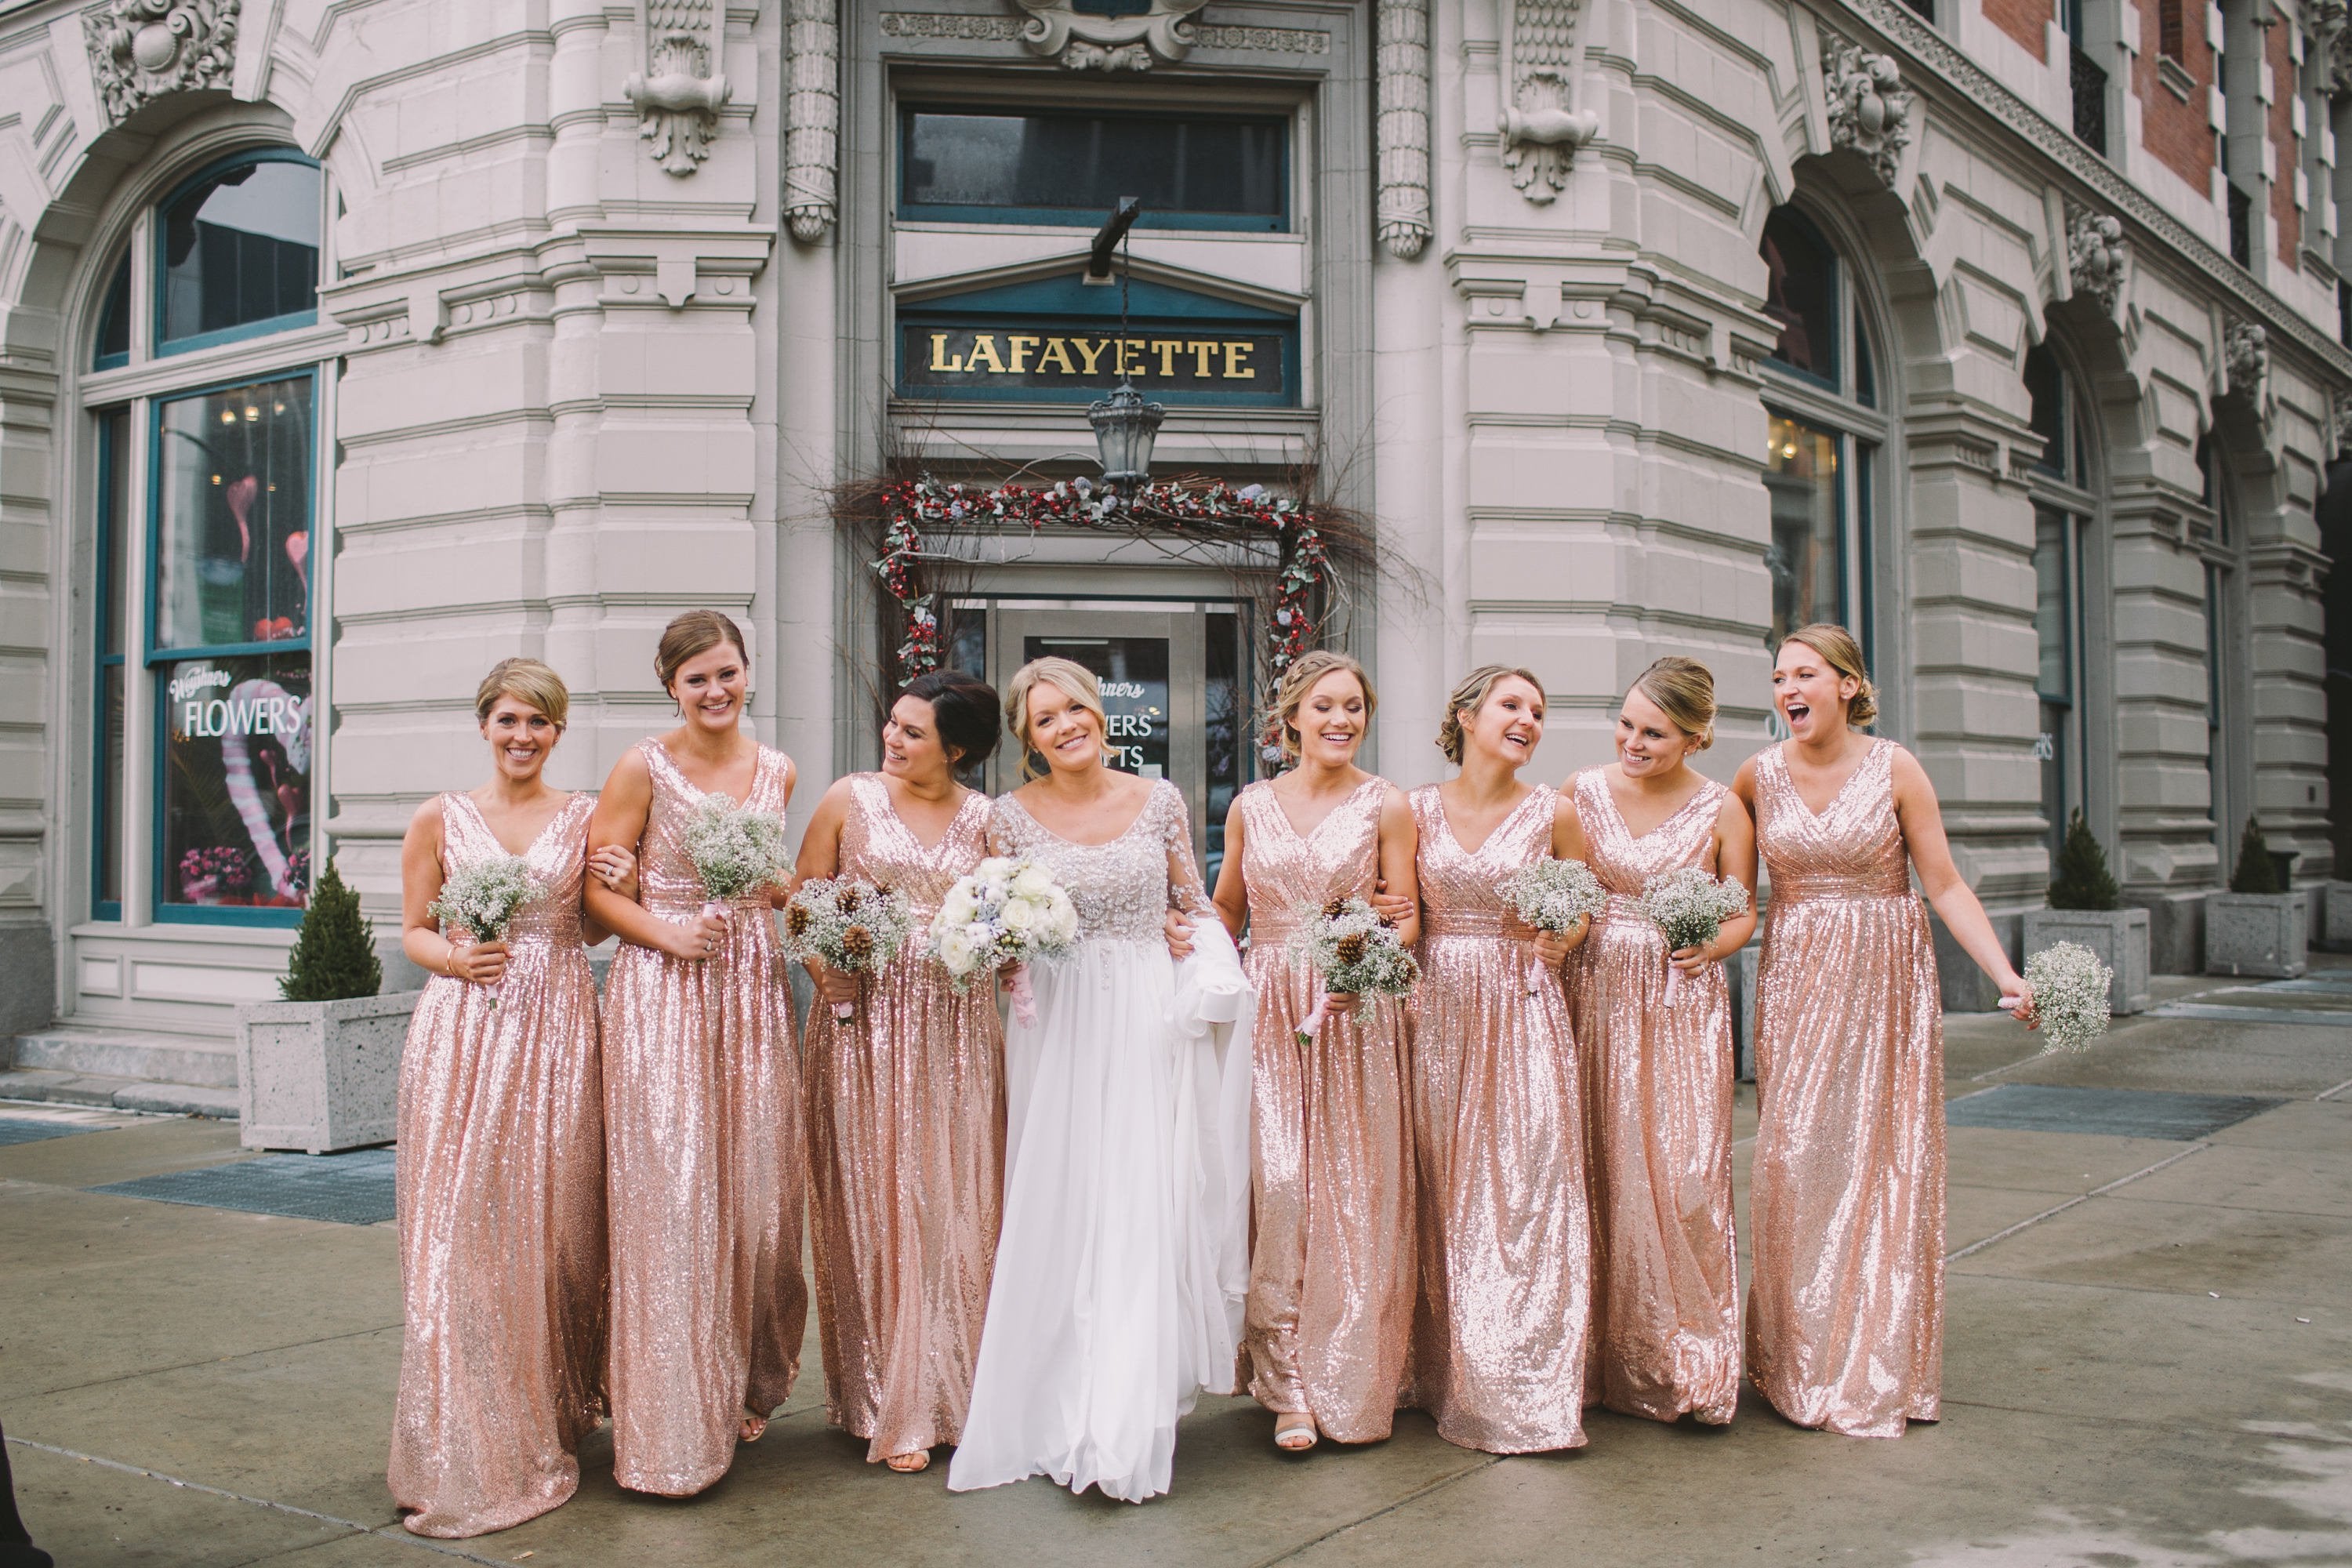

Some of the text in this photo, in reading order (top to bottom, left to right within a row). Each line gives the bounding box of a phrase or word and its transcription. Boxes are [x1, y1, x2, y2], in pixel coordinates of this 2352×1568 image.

[930, 334, 1255, 378] LAFAYETTE
[1097, 676, 1145, 699] hners
[185, 695, 302, 737] FLOWERS
[1105, 714, 1152, 737] ERS
